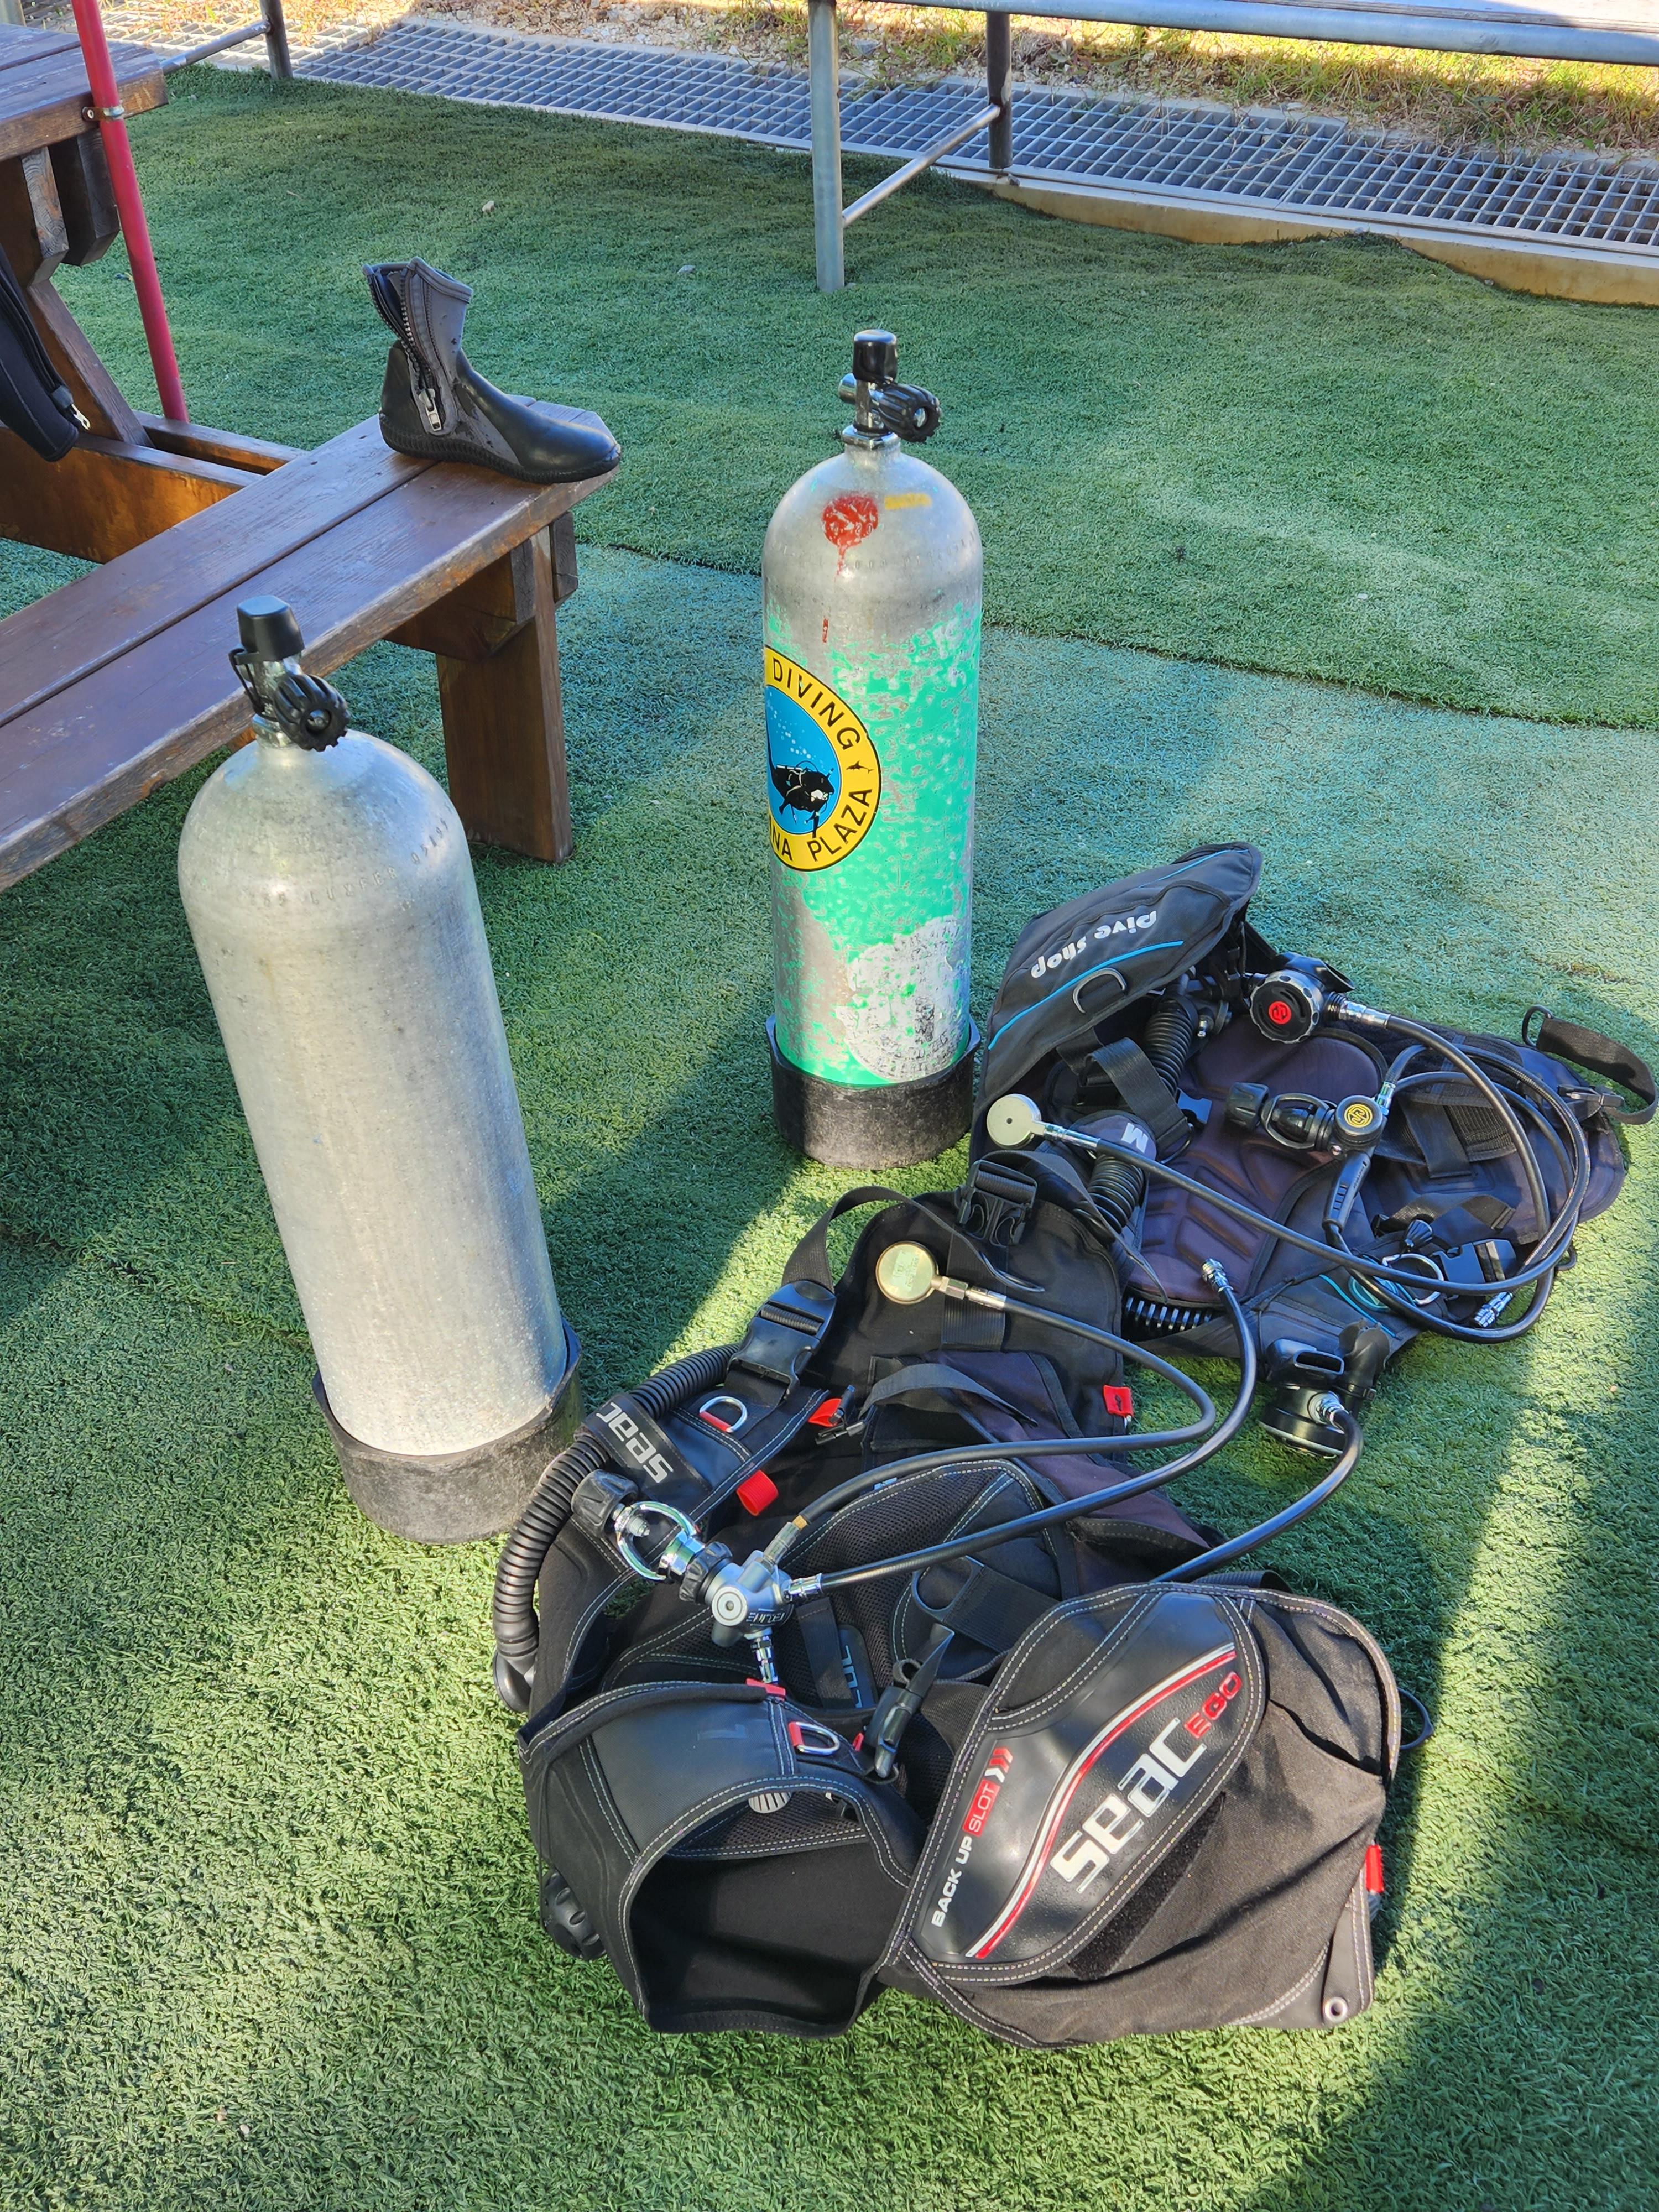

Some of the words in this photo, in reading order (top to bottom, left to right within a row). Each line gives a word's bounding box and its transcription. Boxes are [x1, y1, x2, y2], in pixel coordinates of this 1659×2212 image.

[773, 656, 861, 750] DIVING
[806, 788, 873, 862] PLAZA
[1031, 936, 1087, 978] shop
[1094, 910, 1156, 939] Dive
[1184, 1671, 1243, 1739] EGO
[931, 1868, 962, 1927] BACK
[955, 1835, 973, 1865] UP
[968, 1782, 995, 1833] SLOT
